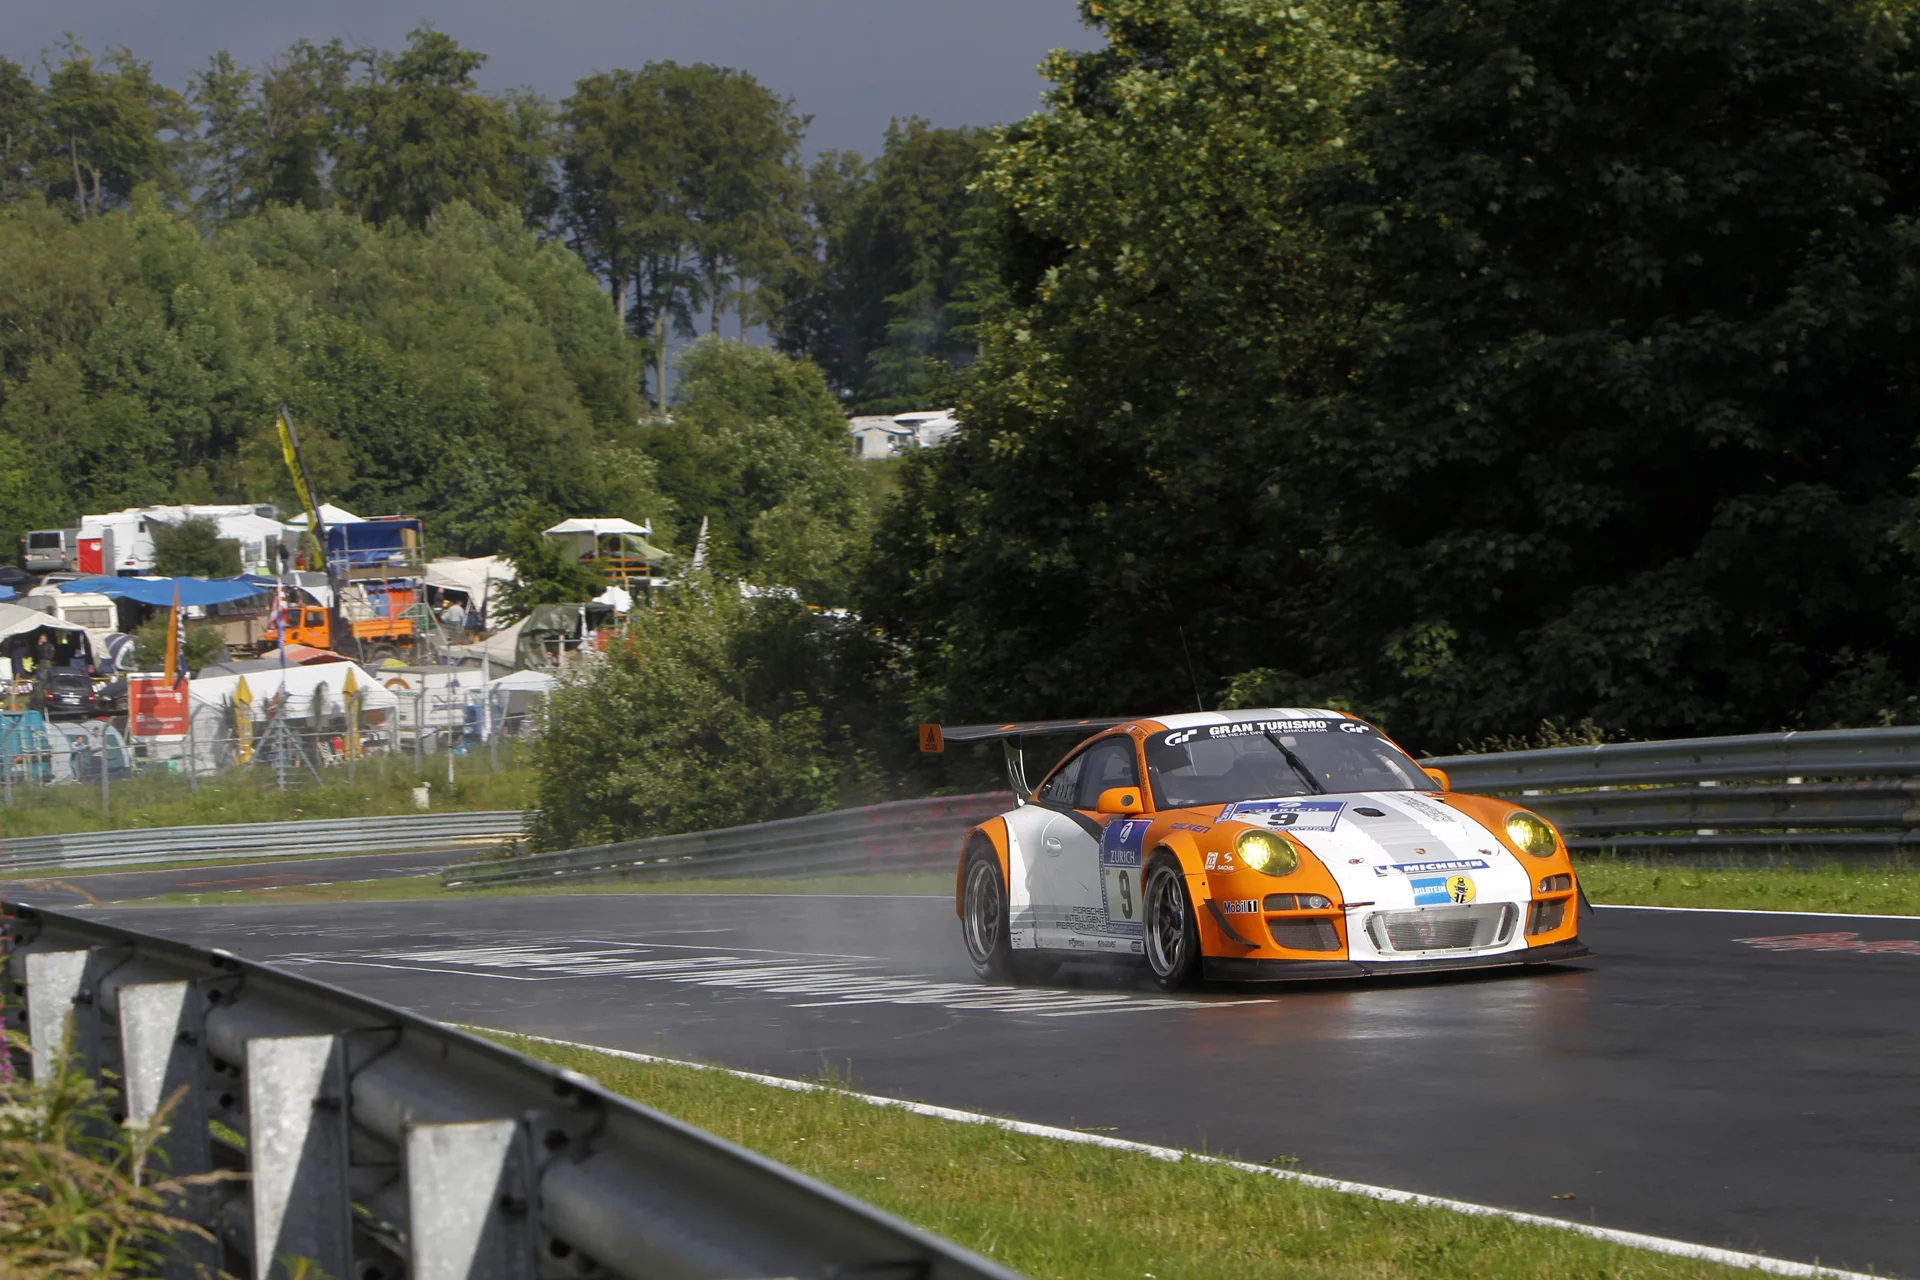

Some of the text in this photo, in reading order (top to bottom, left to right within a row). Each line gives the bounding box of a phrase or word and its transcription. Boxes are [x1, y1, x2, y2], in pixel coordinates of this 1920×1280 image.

[1209, 720, 1327, 736] GRAN TURISMO
[1267, 813, 1299, 826] 9
[1110, 850, 1135, 864] ZURICH
[1403, 860, 1483, 872] MICHELIN
[1119, 870, 1133, 919] 9
[1413, 885, 1447, 896] BILSTEIN
[1073, 906, 1104, 915] PORSCHE
[1224, 900, 1246, 913] Mobil
[1065, 914, 1105, 924] INTELLIGENT
[1056, 922, 1106, 932] PERFORMANCE
